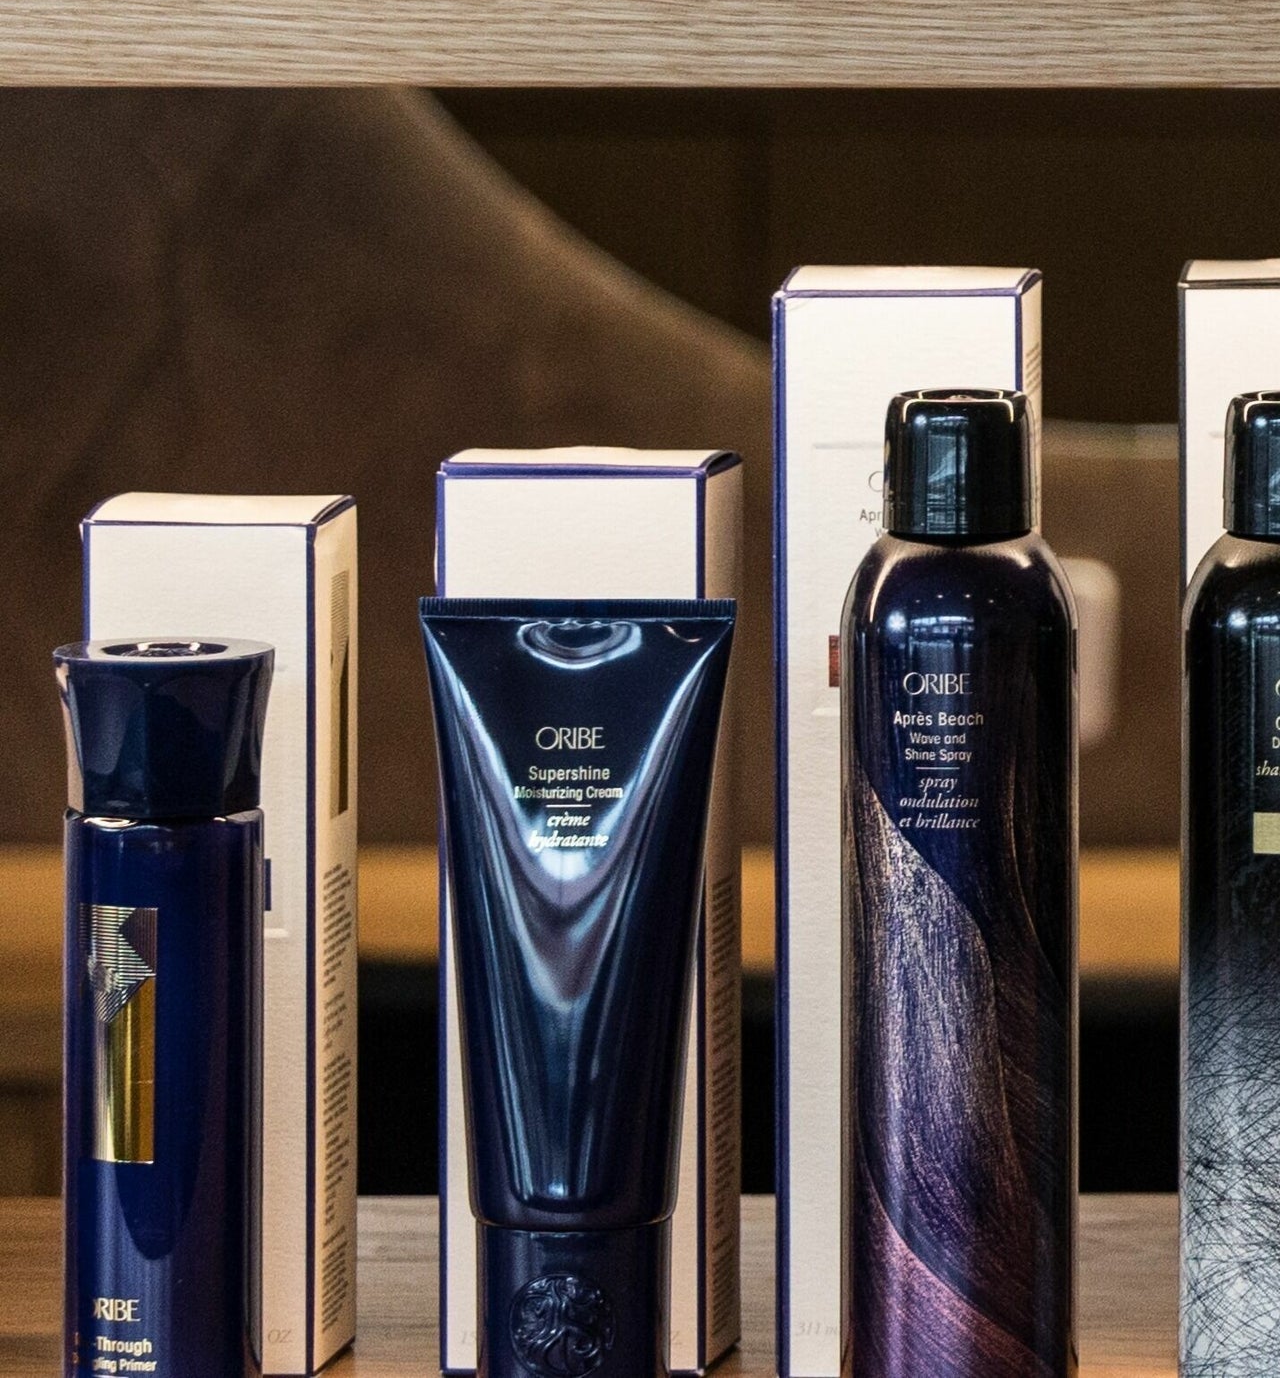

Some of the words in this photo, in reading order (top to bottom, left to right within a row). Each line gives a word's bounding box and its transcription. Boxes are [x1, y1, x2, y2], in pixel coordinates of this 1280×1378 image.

[859, 508, 883, 524] Apr
[902, 672, 973, 696] ORIBE
[893, 710, 934, 728] Après
[938, 711, 984, 726] Beach
[535, 726, 606, 750] ORIBE
[909, 732, 941, 745] Wave
[944, 733, 967, 745] and
[905, 748, 937, 761] Shine
[939, 749, 973, 763] Spray
[529, 765, 611, 784] Supershine
[918, 777, 959, 793] spray
[514, 786, 583, 802] Moisturizing
[586, 786, 624, 799] Cream
[899, 792, 980, 809] ondulation
[547, 811, 592, 827] crème
[898, 816, 912, 828] et
[915, 812, 982, 829] brillance
[528, 830, 610, 853] hydratante
[93, 1297, 142, 1322] RIBE
[119, 1358, 157, 1372] Primer
